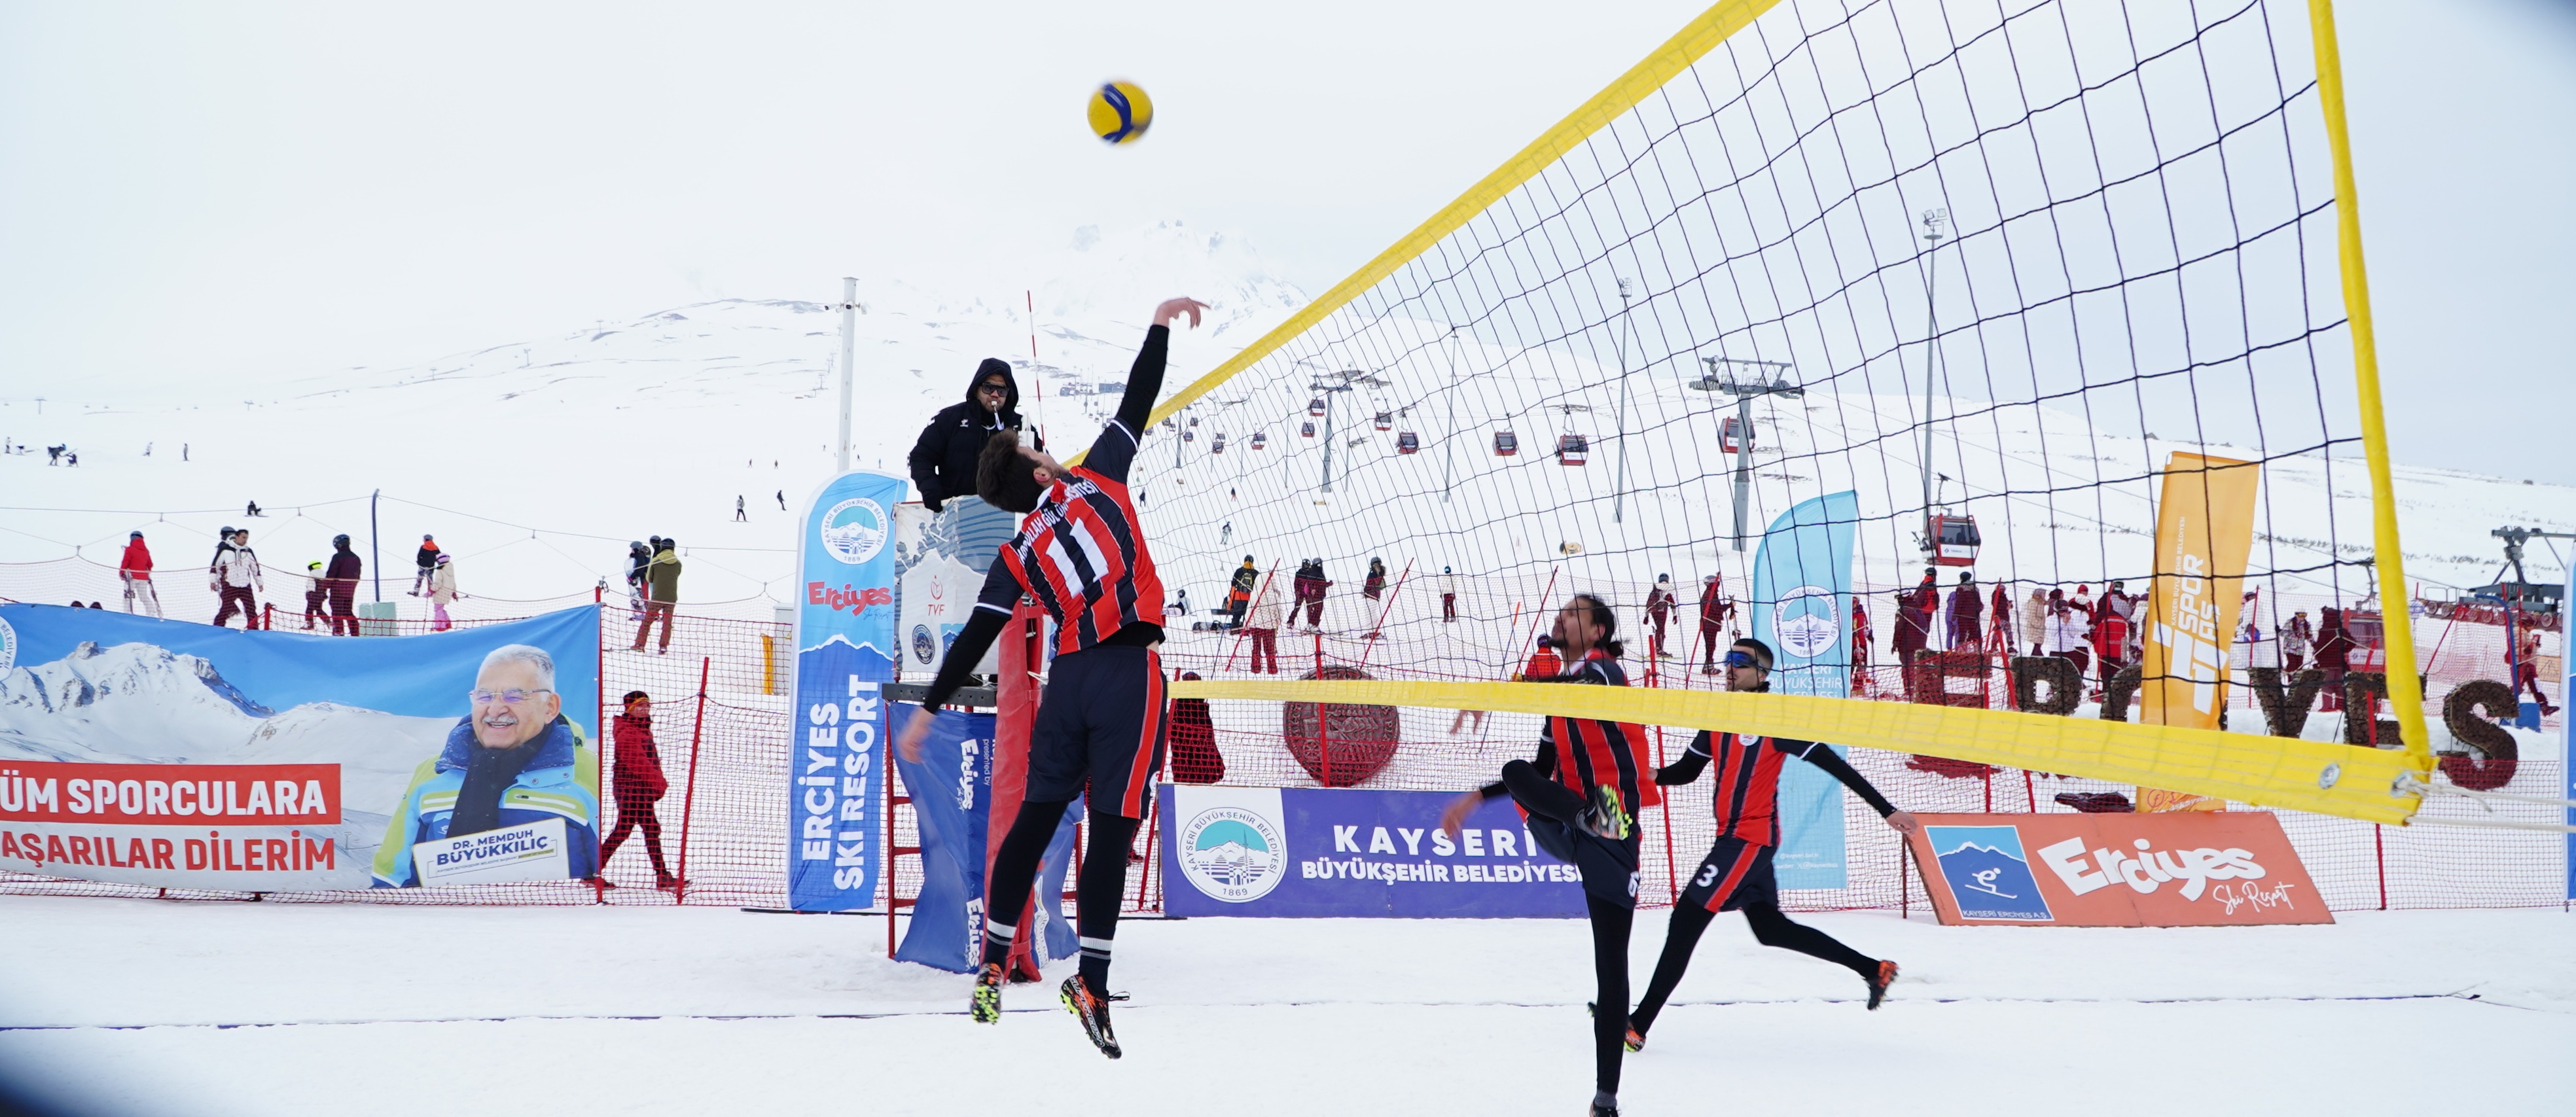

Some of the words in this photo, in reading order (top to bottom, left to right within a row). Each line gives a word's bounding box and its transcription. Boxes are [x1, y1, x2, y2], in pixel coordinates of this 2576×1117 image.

[1045, 517, 1110, 599] 11
[808, 581, 893, 616] Erciyes
[928, 604, 946, 616] TVF
[2178, 554, 2204, 633] SPOR
[841, 674, 878, 821] RESORT
[982, 739, 991, 775] presented
[798, 703, 840, 860] ERCİYES
[959, 738, 980, 810] Erciyes
[983, 776, 992, 786] by
[0, 770, 59, 813] ÜM
[67, 778, 327, 817] SPORCULARA
[1, 831, 175, 870] AŞARILAR
[184, 830, 335, 871] DİLERİM
[437, 836, 548, 866] BÜYÜKKILIÇ
[453, 841, 474, 851] DR.
[477, 829, 533, 846] MEMDUH
[1186, 830, 1199, 871] KAYSERİ
[1194, 811, 1255, 830] BÜYÜKŞEHİR
[1257, 823, 1280, 874] BELEDİYESİ
[1333, 823, 1538, 857] KAYSERİ
[833, 831, 864, 890] SKI
[1301, 857, 1450, 886] BÜYÜKŞEHİR
[1696, 864, 1719, 887] 3
[2037, 836, 2266, 902] Erciyes
[1223, 888, 1248, 896] 1869
[2213, 881, 2244, 915] Ski
[2242, 881, 2295, 913] Resort
[1997, 910, 2032, 919] ERCİYES
